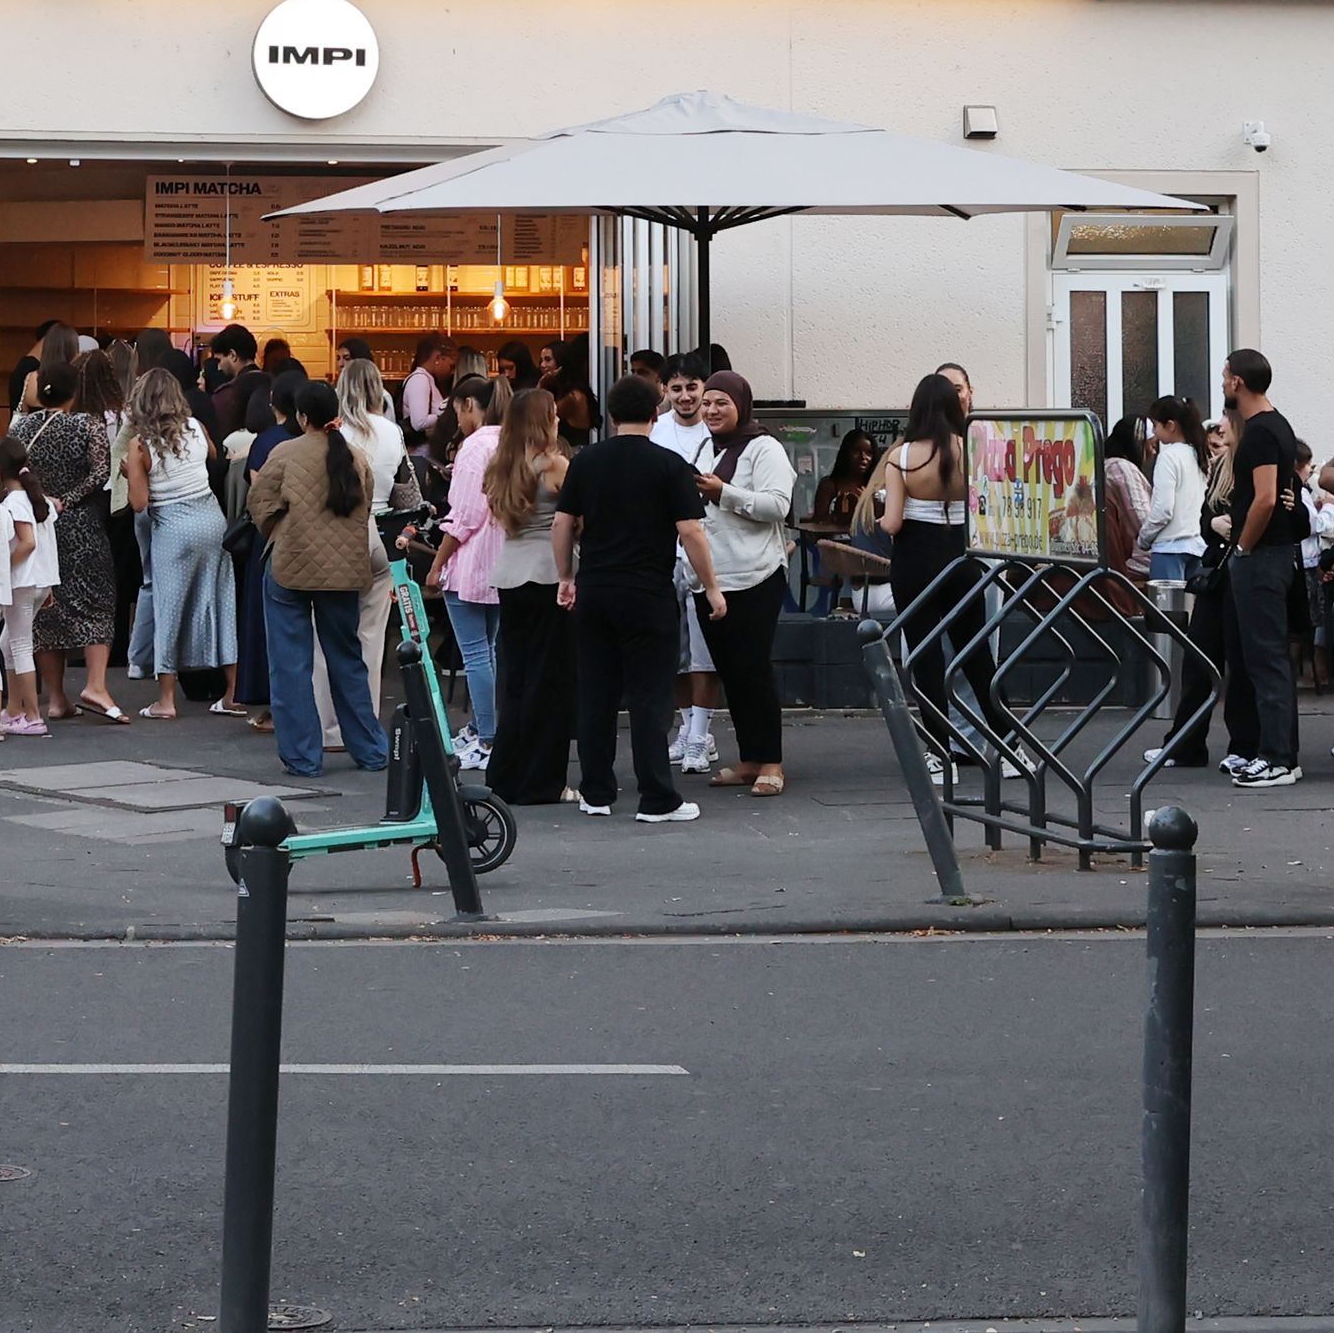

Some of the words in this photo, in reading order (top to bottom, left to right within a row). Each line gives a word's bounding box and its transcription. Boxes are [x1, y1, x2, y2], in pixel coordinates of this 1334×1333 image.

[269, 46, 366, 66] IMPI
[155, 182, 189, 195] IMPI
[194, 182, 262, 195] MATCHA
[269, 290, 300, 298] EXTRAS
[1022, 425, 1075, 499] Prego
[1027, 497, 1042, 519] 917
[399, 586, 414, 614] GRATIS
